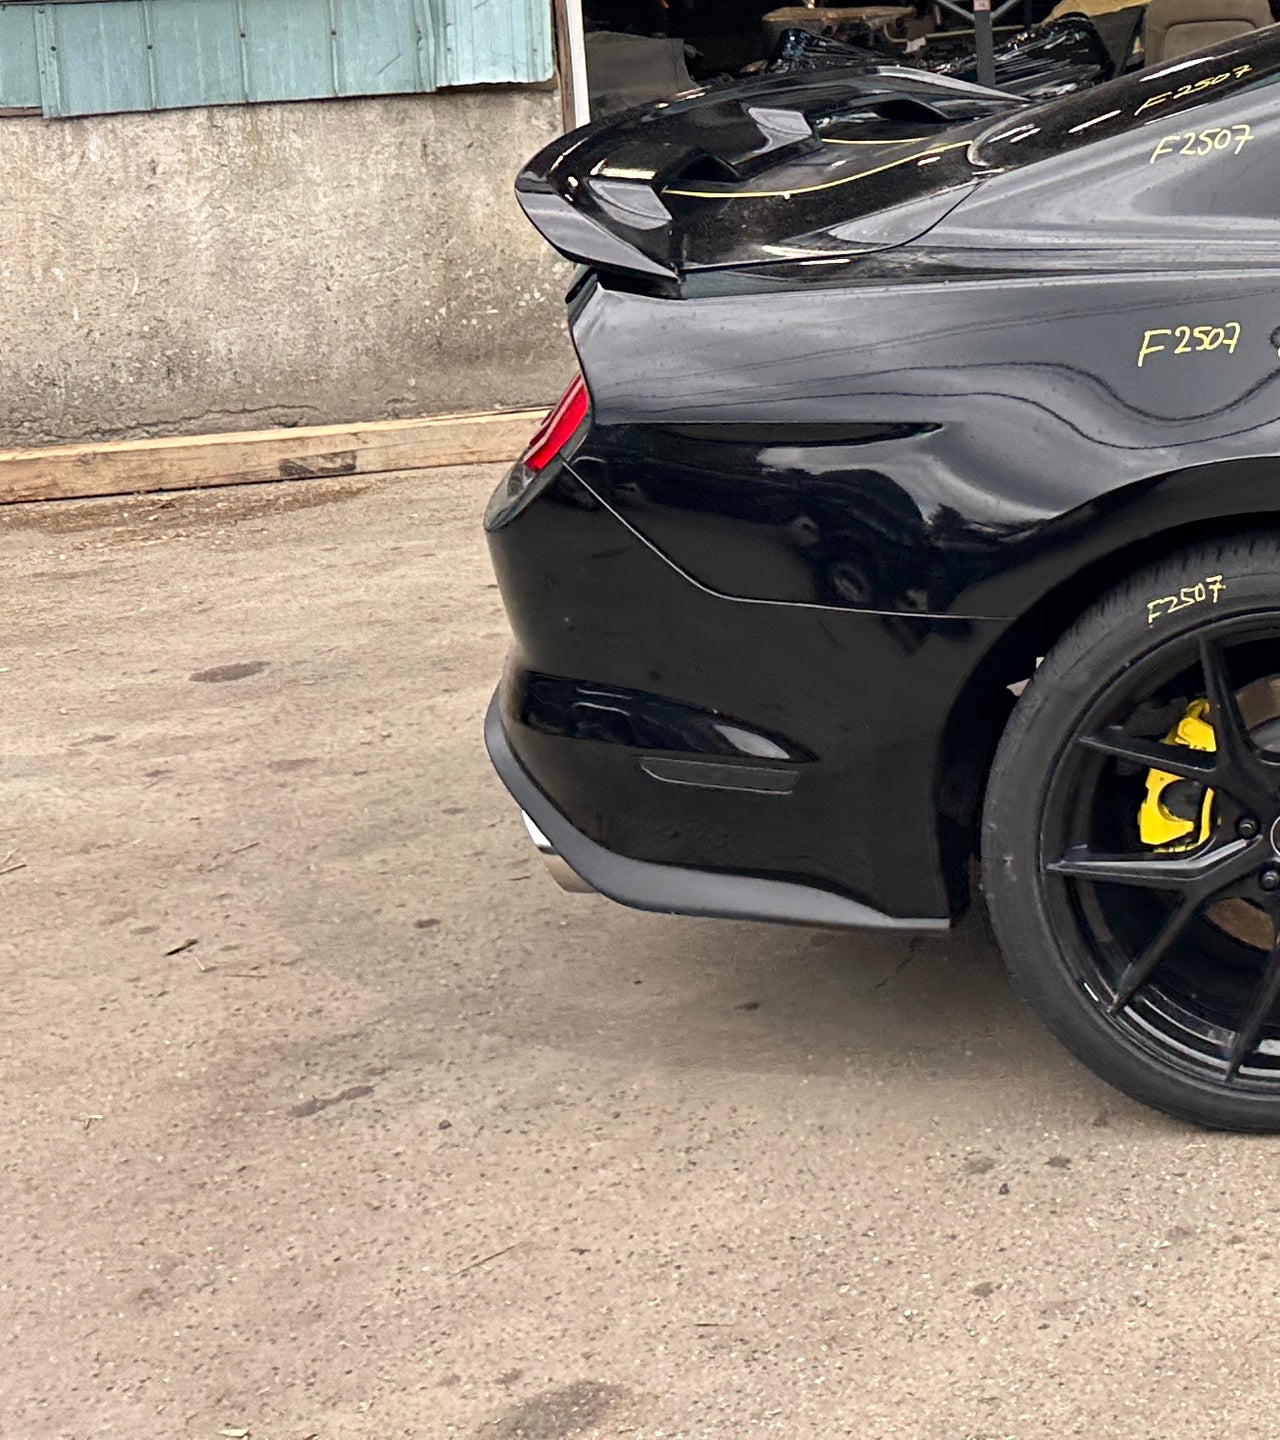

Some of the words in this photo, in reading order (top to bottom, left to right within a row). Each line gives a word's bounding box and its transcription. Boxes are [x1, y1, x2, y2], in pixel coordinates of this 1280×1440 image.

[1134, 64, 1252, 116] F2507
[1150, 124, 1254, 164] F2507
[1137, 321, 1241, 367] F2507
[1146, 575, 1227, 624] F2507
